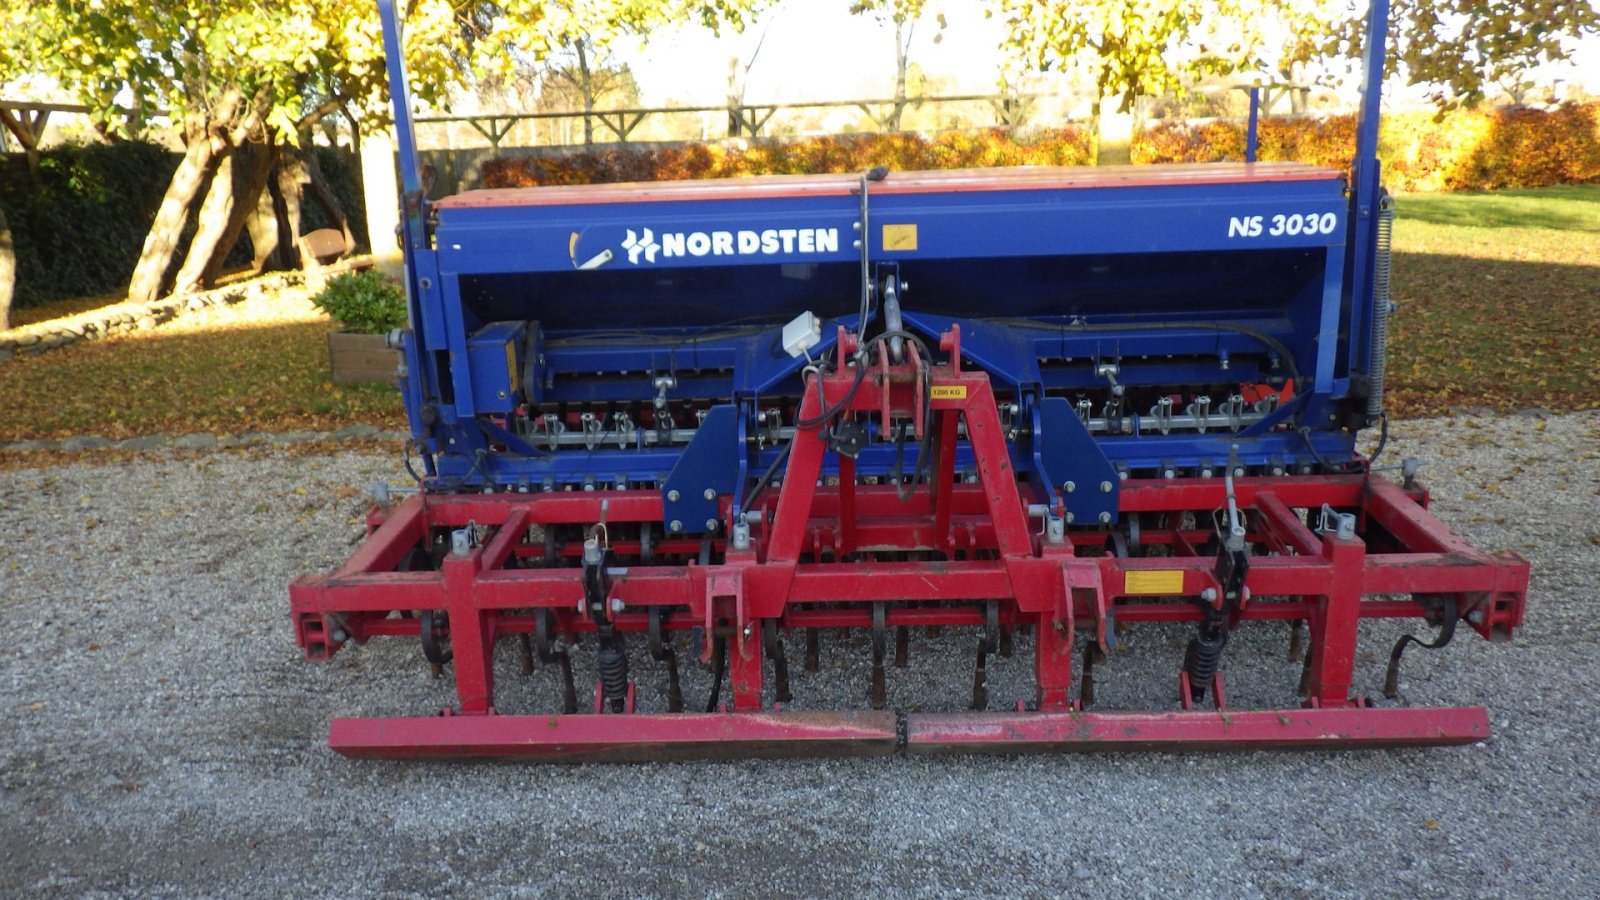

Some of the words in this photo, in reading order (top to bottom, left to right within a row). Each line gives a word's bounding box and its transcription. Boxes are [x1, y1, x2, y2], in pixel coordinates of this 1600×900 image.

[1228, 215, 1263, 237] NS
[1269, 212, 1337, 236] 3030
[662, 228, 839, 257] NORDSTEN
